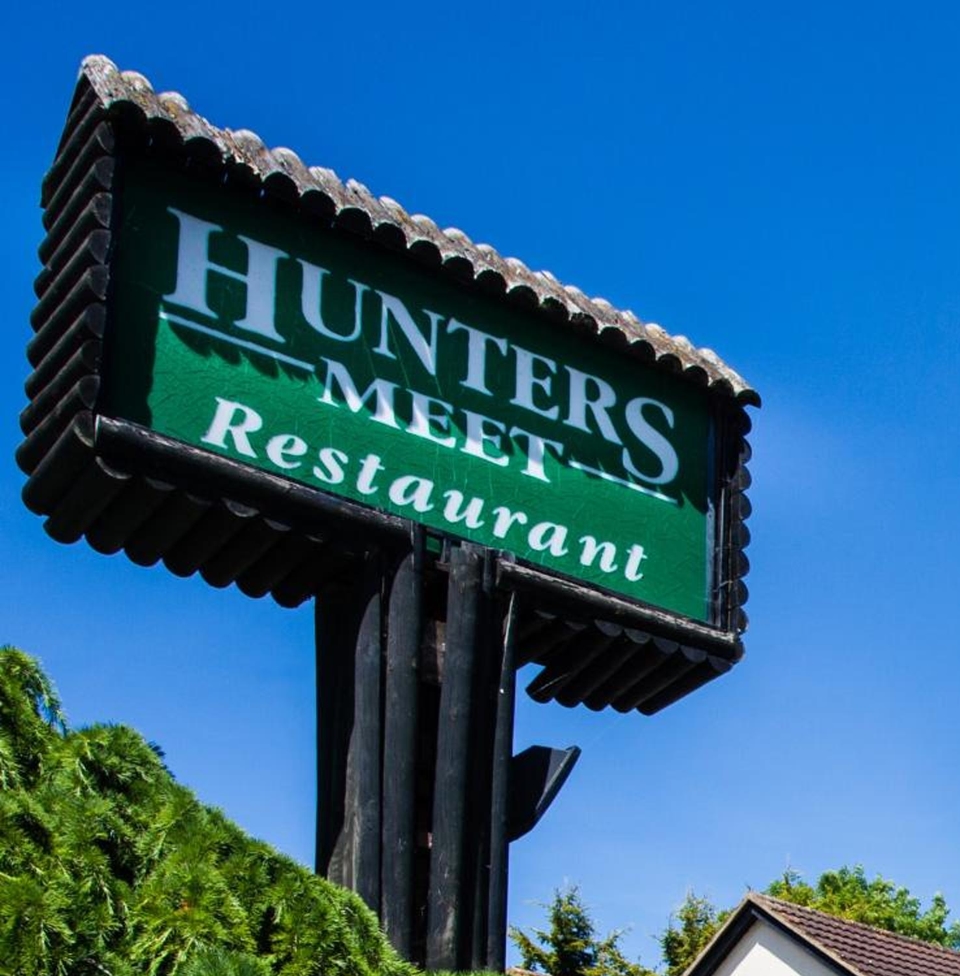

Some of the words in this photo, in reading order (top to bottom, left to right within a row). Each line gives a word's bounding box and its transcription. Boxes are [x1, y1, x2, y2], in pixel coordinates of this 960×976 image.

[163, 207, 680, 486] HUNTERS
[318, 357, 564, 483] MEET
[201, 397, 649, 582] Restaurant
